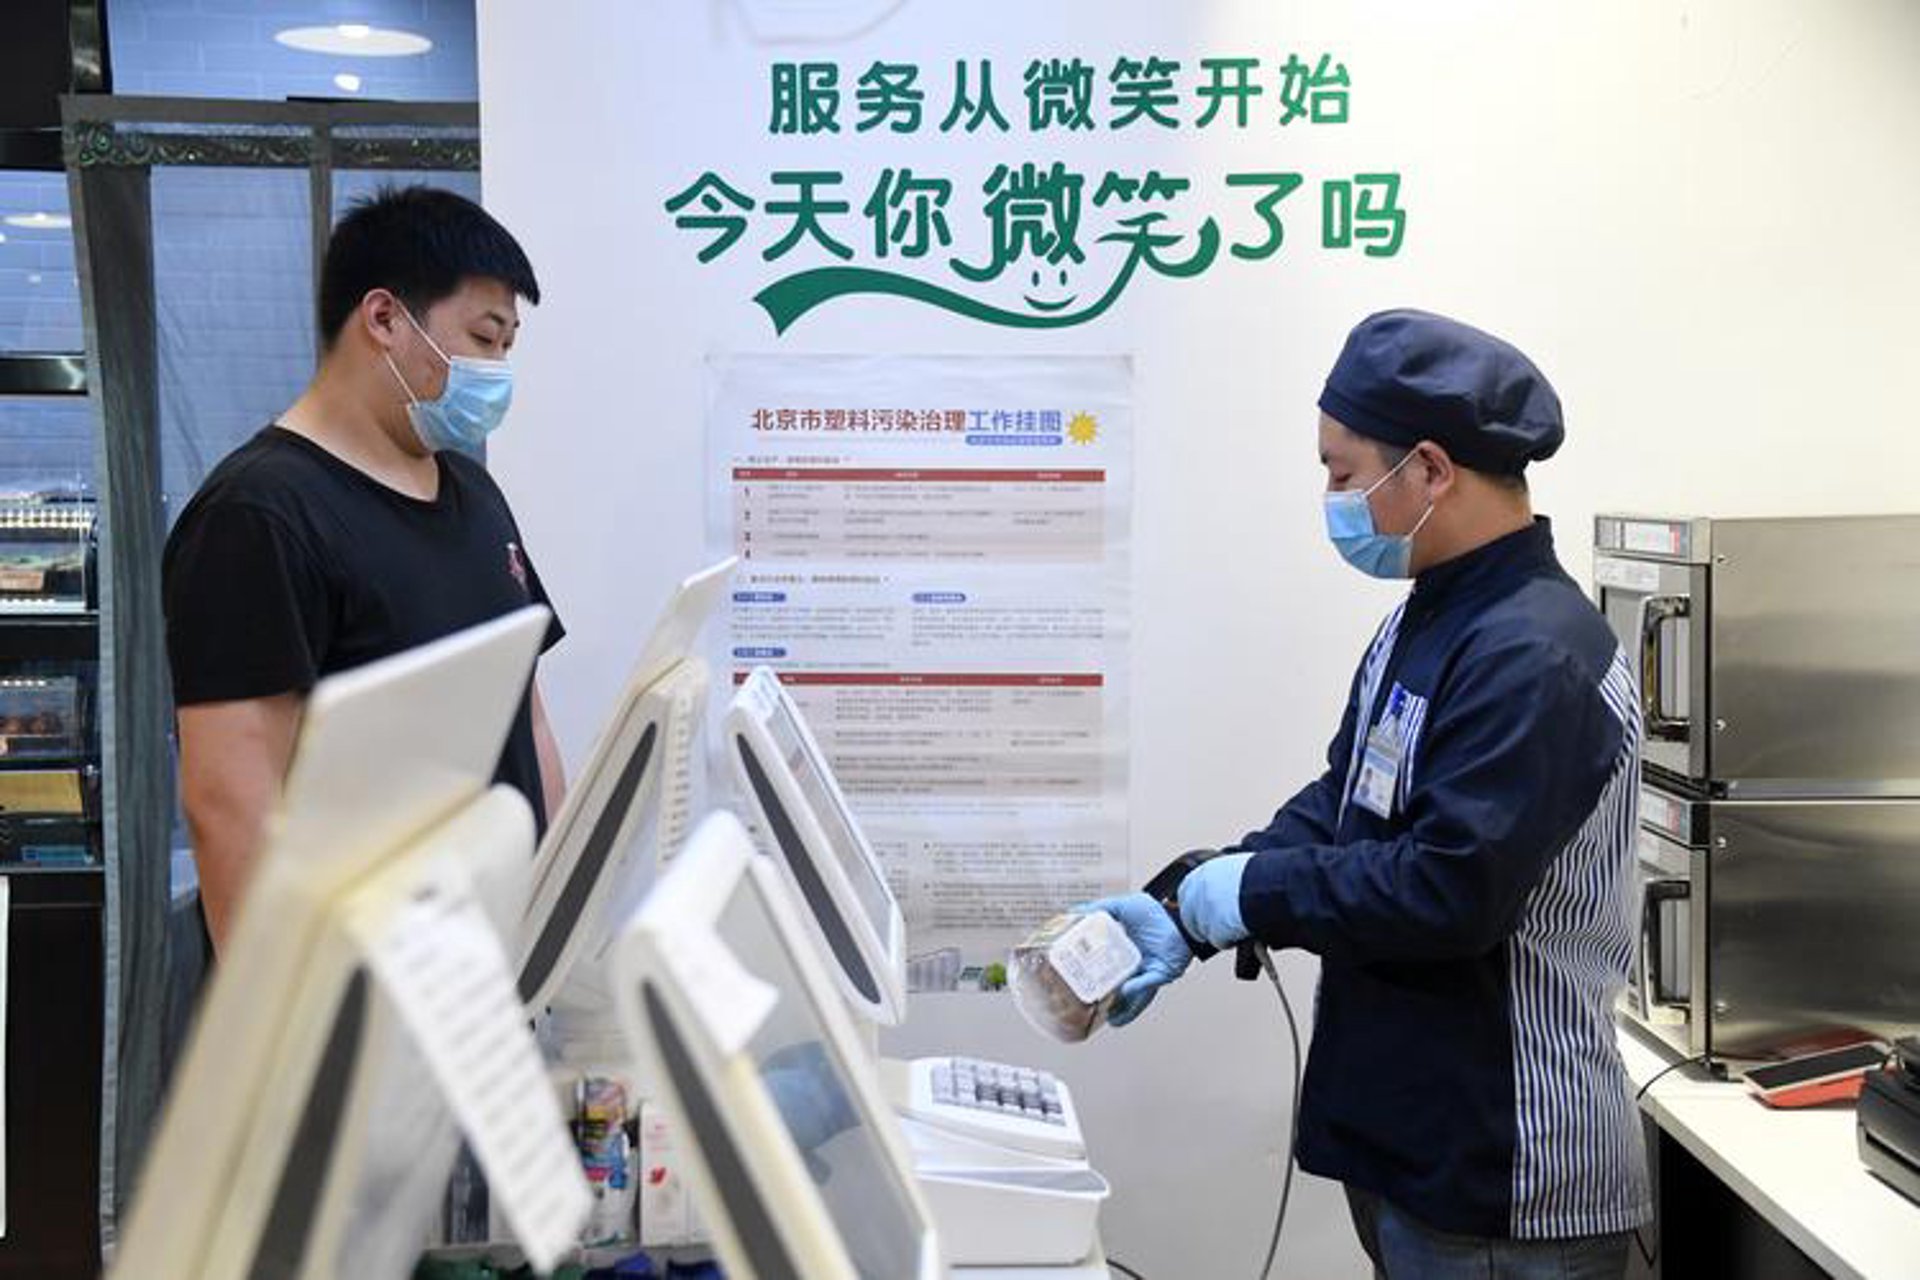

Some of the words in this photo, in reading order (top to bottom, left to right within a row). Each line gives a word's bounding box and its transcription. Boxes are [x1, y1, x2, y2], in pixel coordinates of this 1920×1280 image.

[768, 54, 1352, 134] 服务从微笑开始
[664, 162, 1407, 282] 今天你微笑了吗
[751, 408, 1062, 433] 北京市塑料污染治理工作挂图
